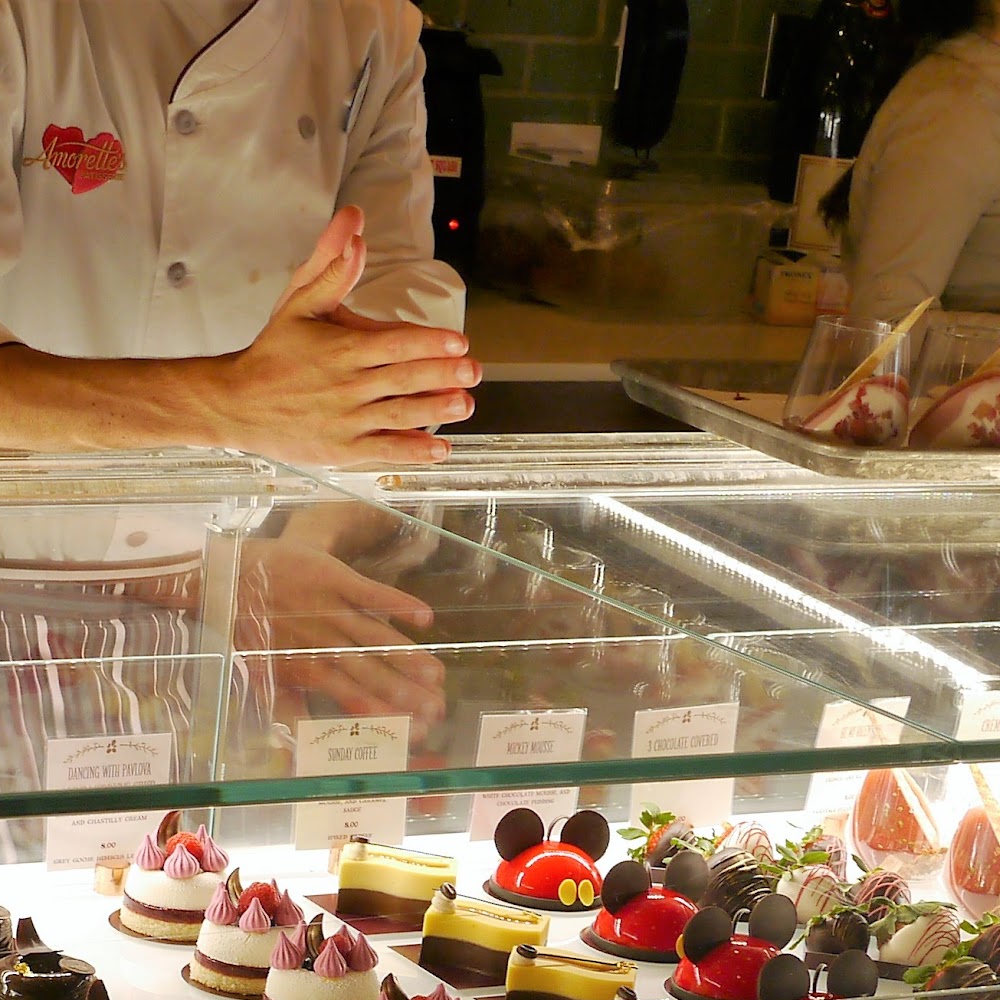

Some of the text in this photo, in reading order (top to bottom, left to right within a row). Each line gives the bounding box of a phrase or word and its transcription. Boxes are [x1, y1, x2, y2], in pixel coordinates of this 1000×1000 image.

[647, 733, 720, 752] 3 CHOCOLATE COVERED
[328, 746, 378, 762] SUNDAY COFFEE
[68, 762, 152, 781] DANCING WITH PAVLOVA
[71, 819, 86, 827] AND
[87, 817, 123, 825] CHANTILLY
